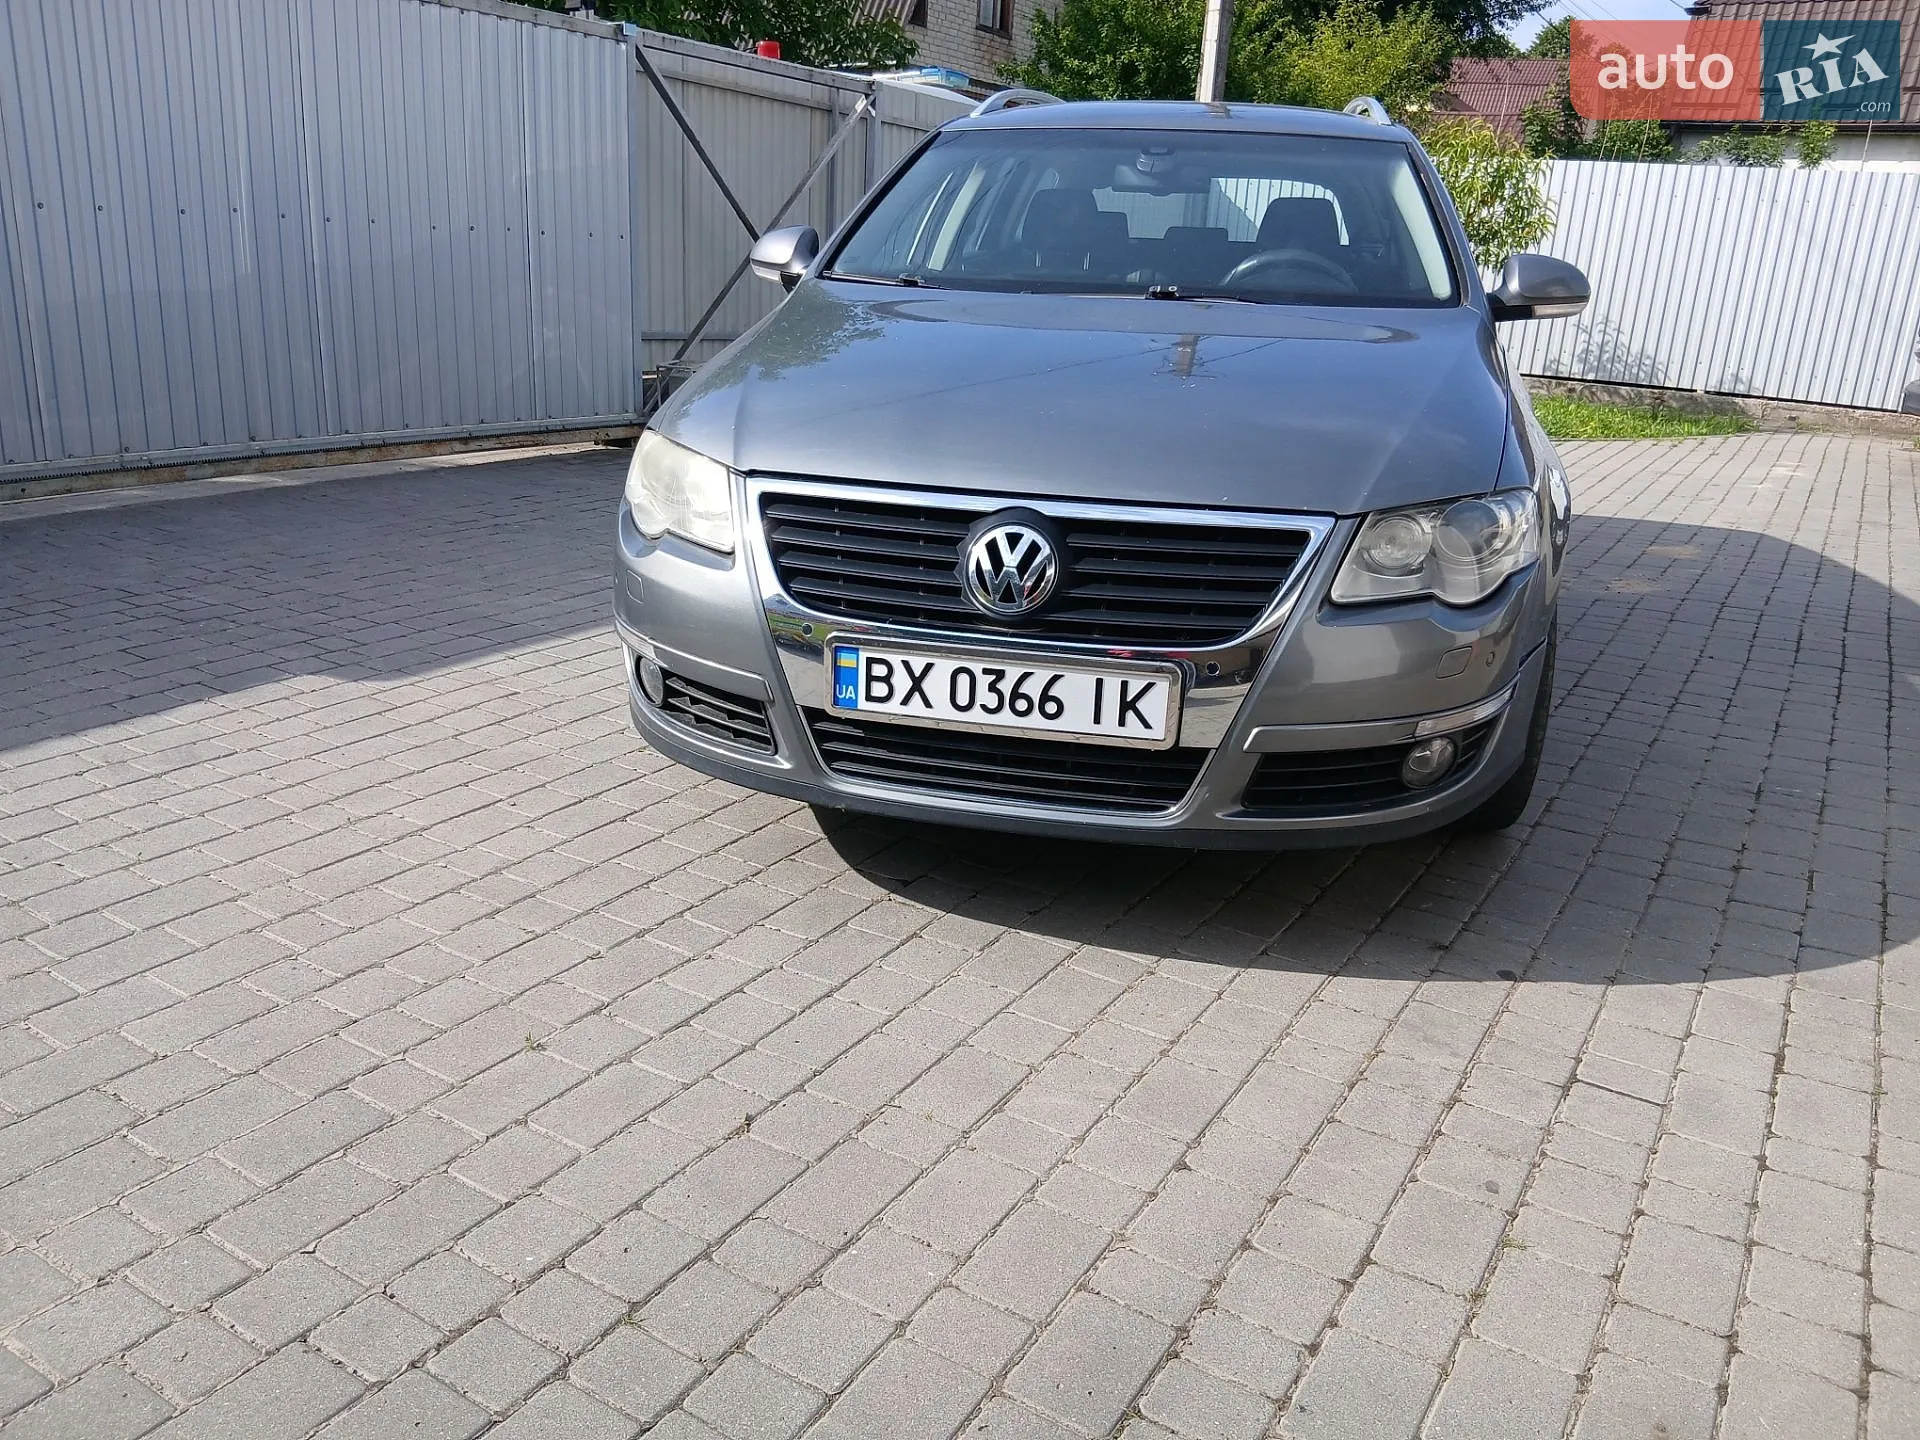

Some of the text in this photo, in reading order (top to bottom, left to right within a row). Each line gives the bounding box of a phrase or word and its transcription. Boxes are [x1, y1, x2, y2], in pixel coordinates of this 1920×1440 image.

[836, 684, 856, 700] UA
[864, 656, 1157, 730] BX 0366 IK
